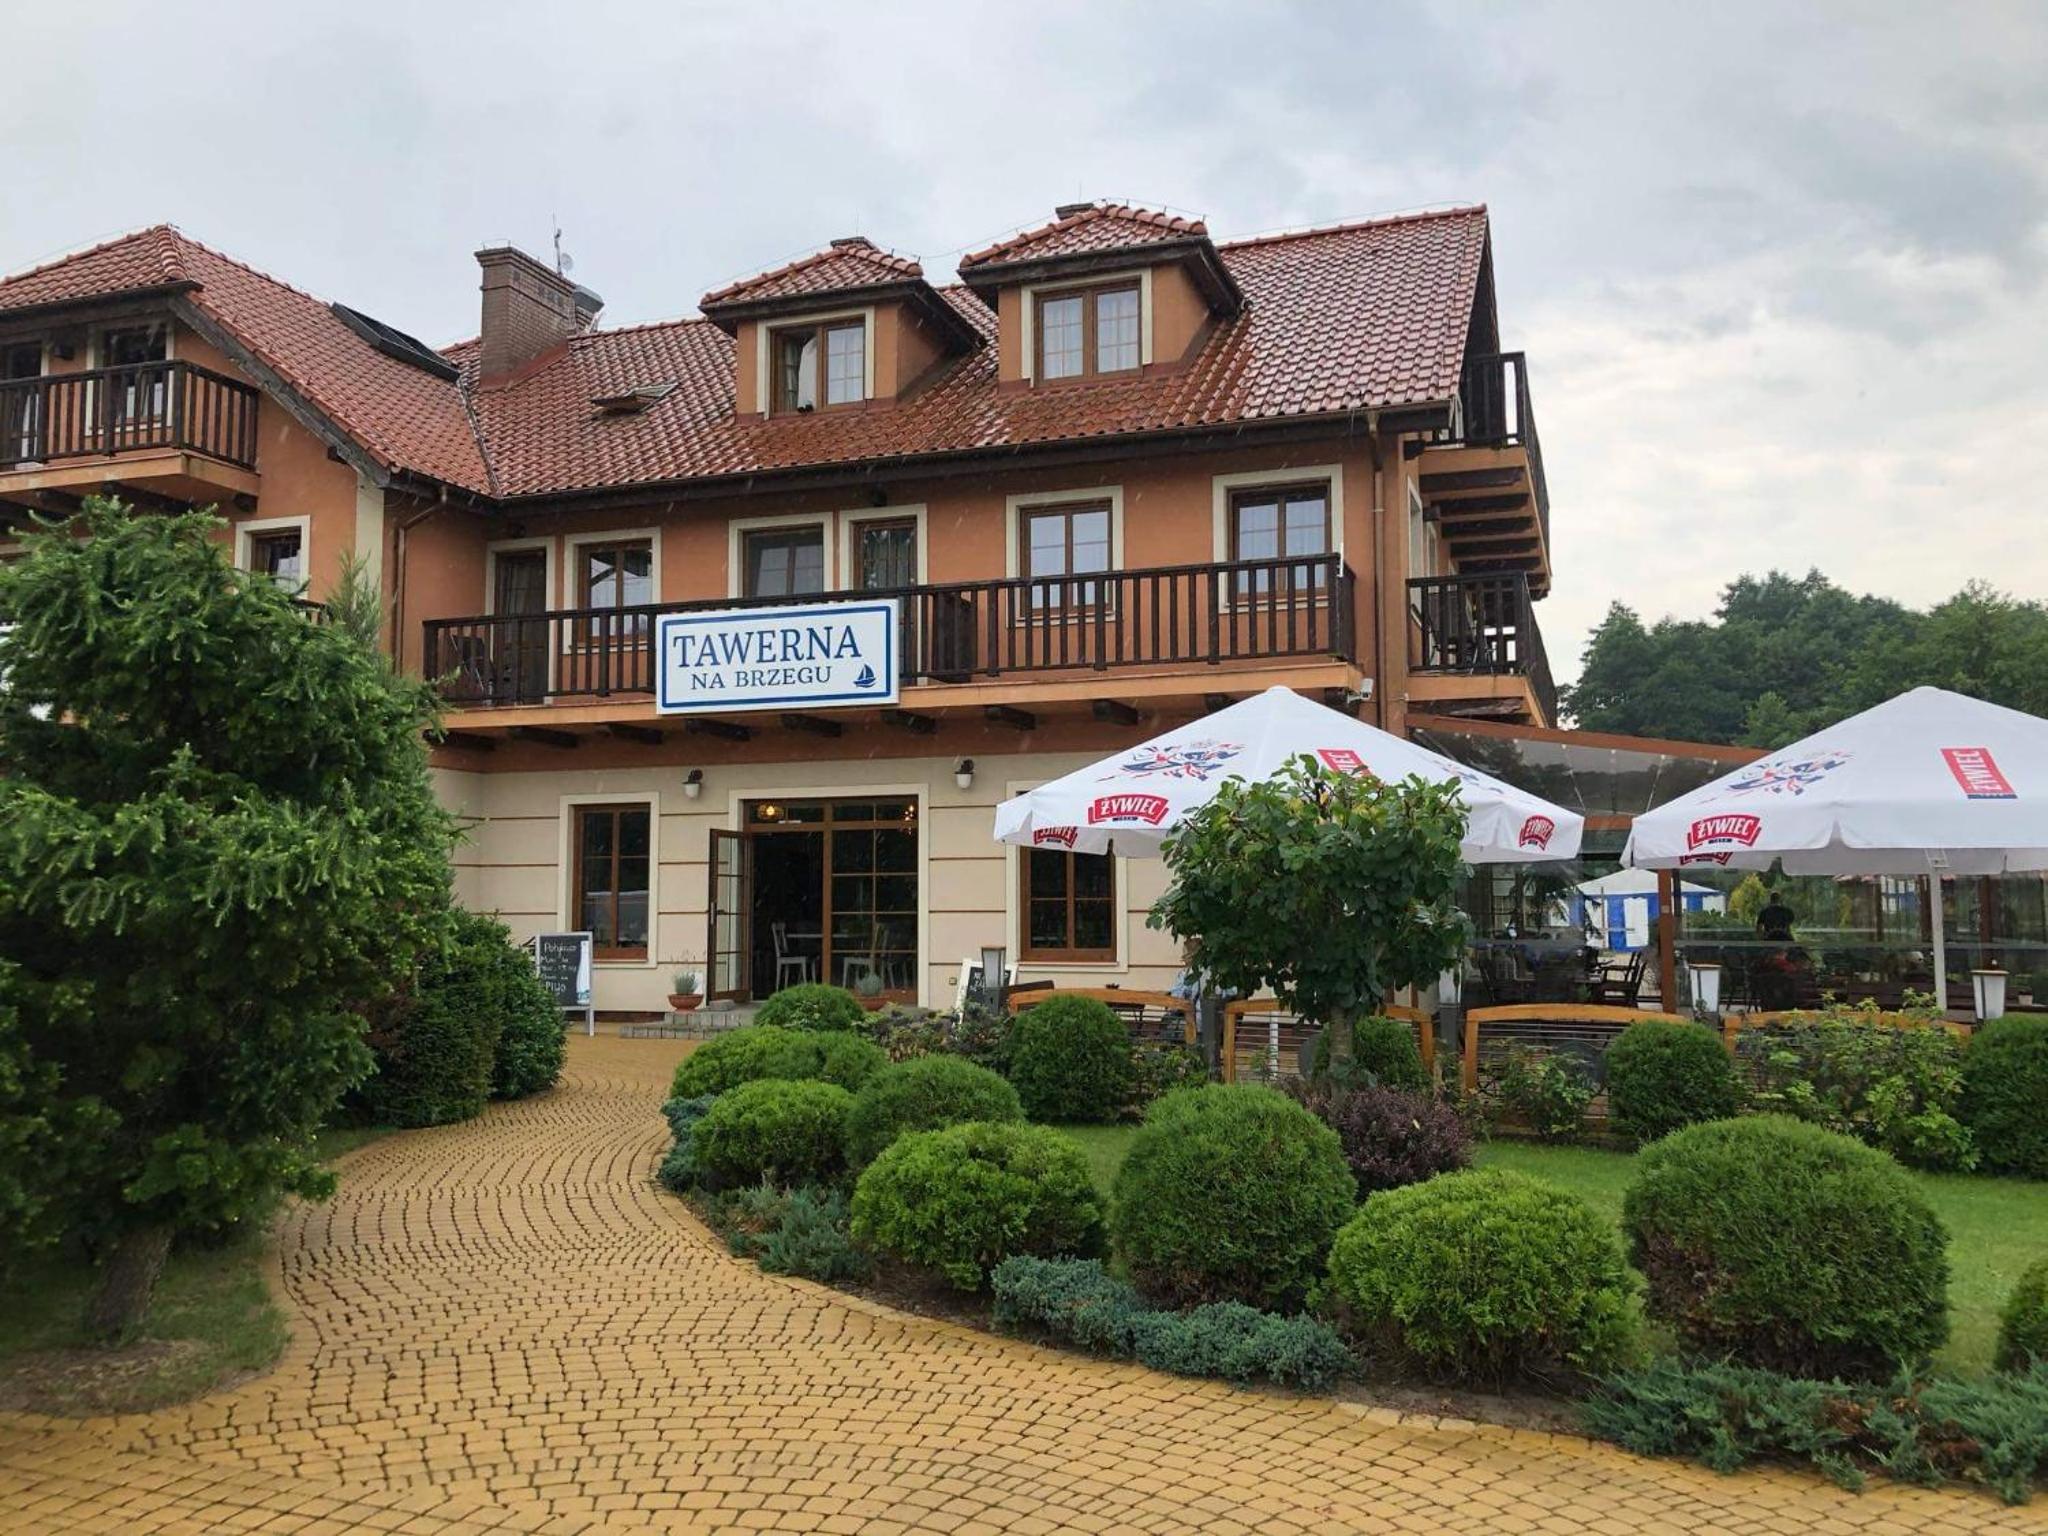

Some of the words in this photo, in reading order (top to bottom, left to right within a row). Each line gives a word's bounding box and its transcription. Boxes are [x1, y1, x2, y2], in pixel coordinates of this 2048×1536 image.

[673, 625, 862, 667] TAWERNA
[690, 673, 725, 690] NA
[735, 666, 832, 688] BRZEGU
[1100, 797, 1161, 816] ŻYWIEC
[1697, 817, 1755, 839] ŻYWIEC
